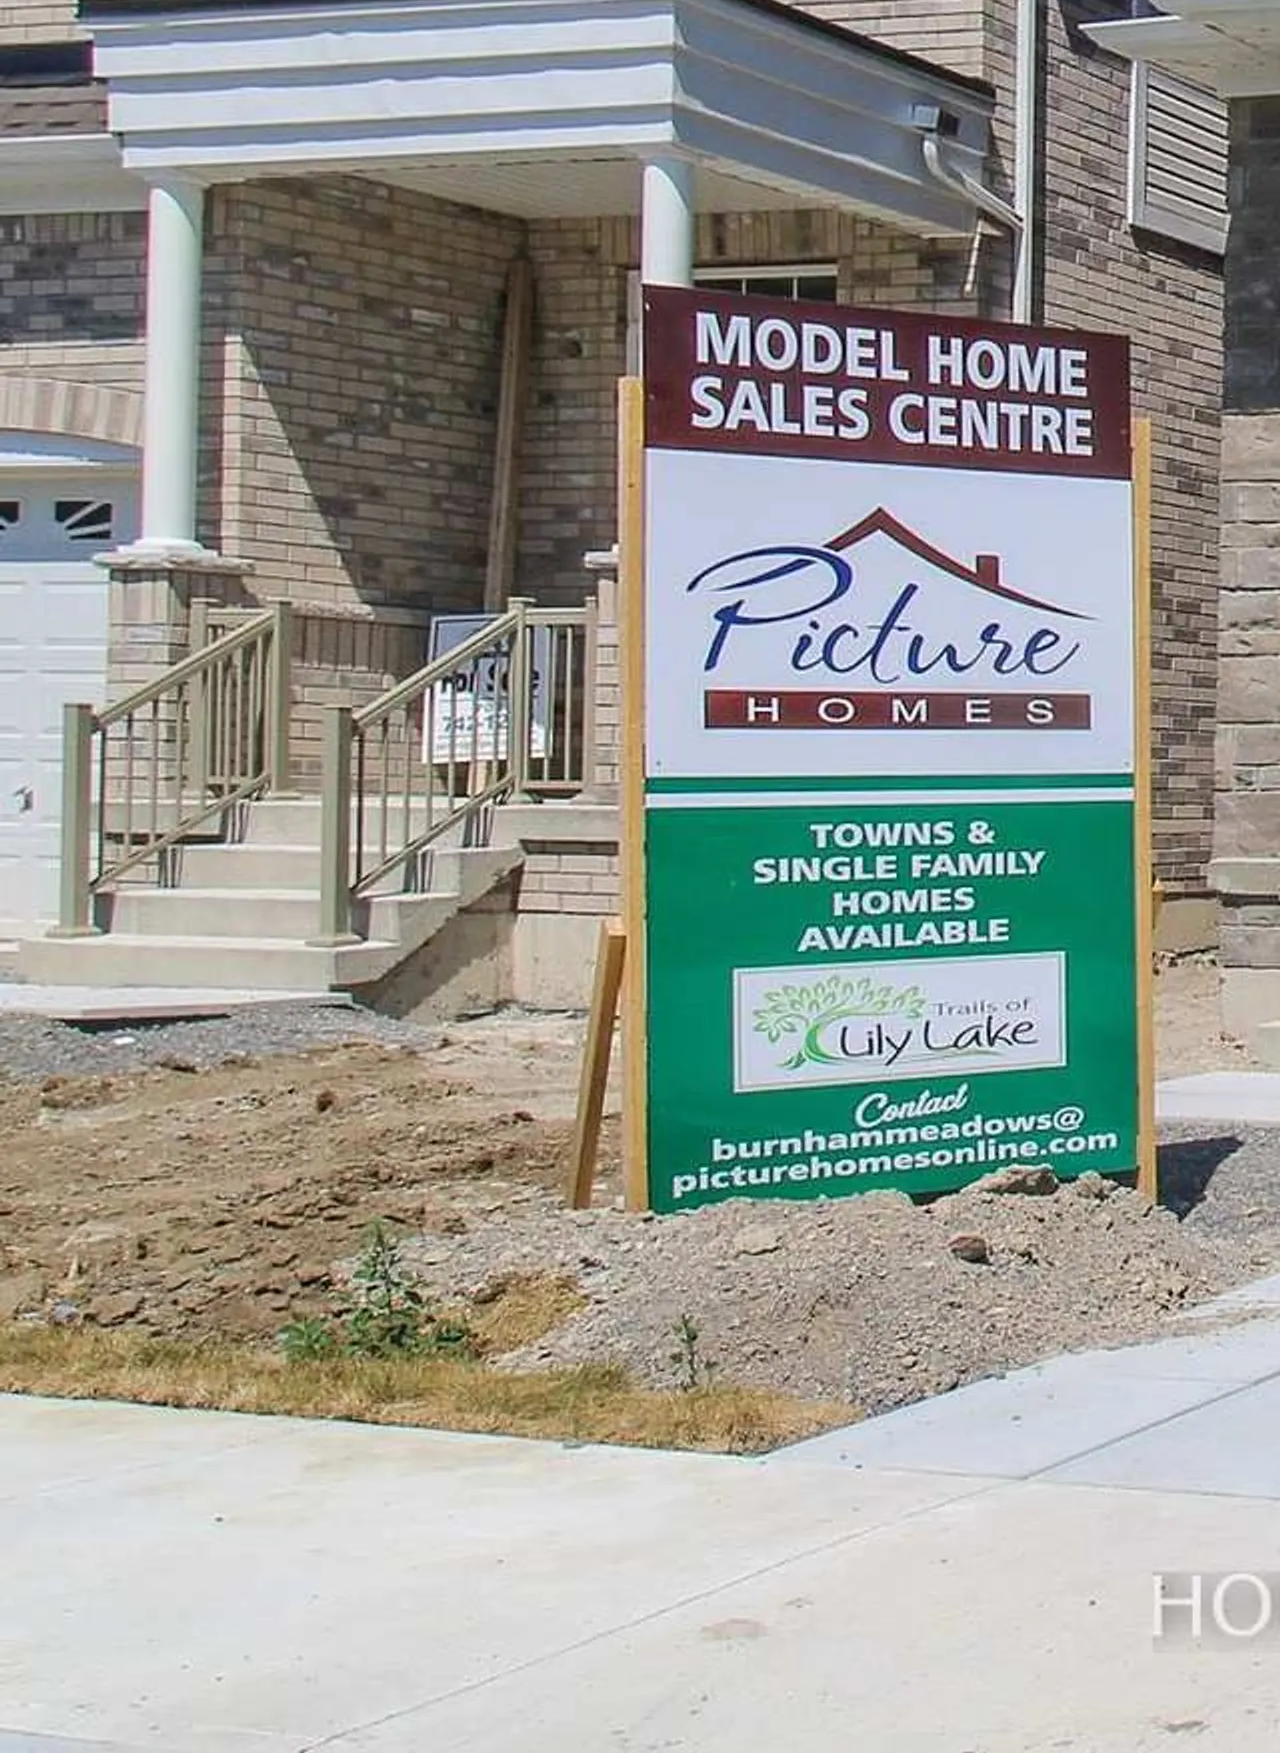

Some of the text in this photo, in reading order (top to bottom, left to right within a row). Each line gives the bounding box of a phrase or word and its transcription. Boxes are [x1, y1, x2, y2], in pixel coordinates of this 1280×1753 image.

[695, 311, 1087, 398] MODEL HOME
[690, 376, 1093, 457] SALES CENTRE
[687, 546, 1079, 684] Picture
[747, 696, 1055, 724] HOMES
[810, 820, 995, 848] TOWNS &
[753, 850, 1046, 884] SINGLE FAMILY
[833, 887, 975, 916] HOMES
[798, 918, 1010, 952] AVAILABLE
[933, 997, 1031, 1017] Trails of
[839, 1015, 1040, 1066] Lily Lake
[854, 1083, 969, 1128] Contact
[712, 1107, 1085, 1162] burnhammeadows@
[672, 1130, 1118, 1198] picturehomesonline.com
